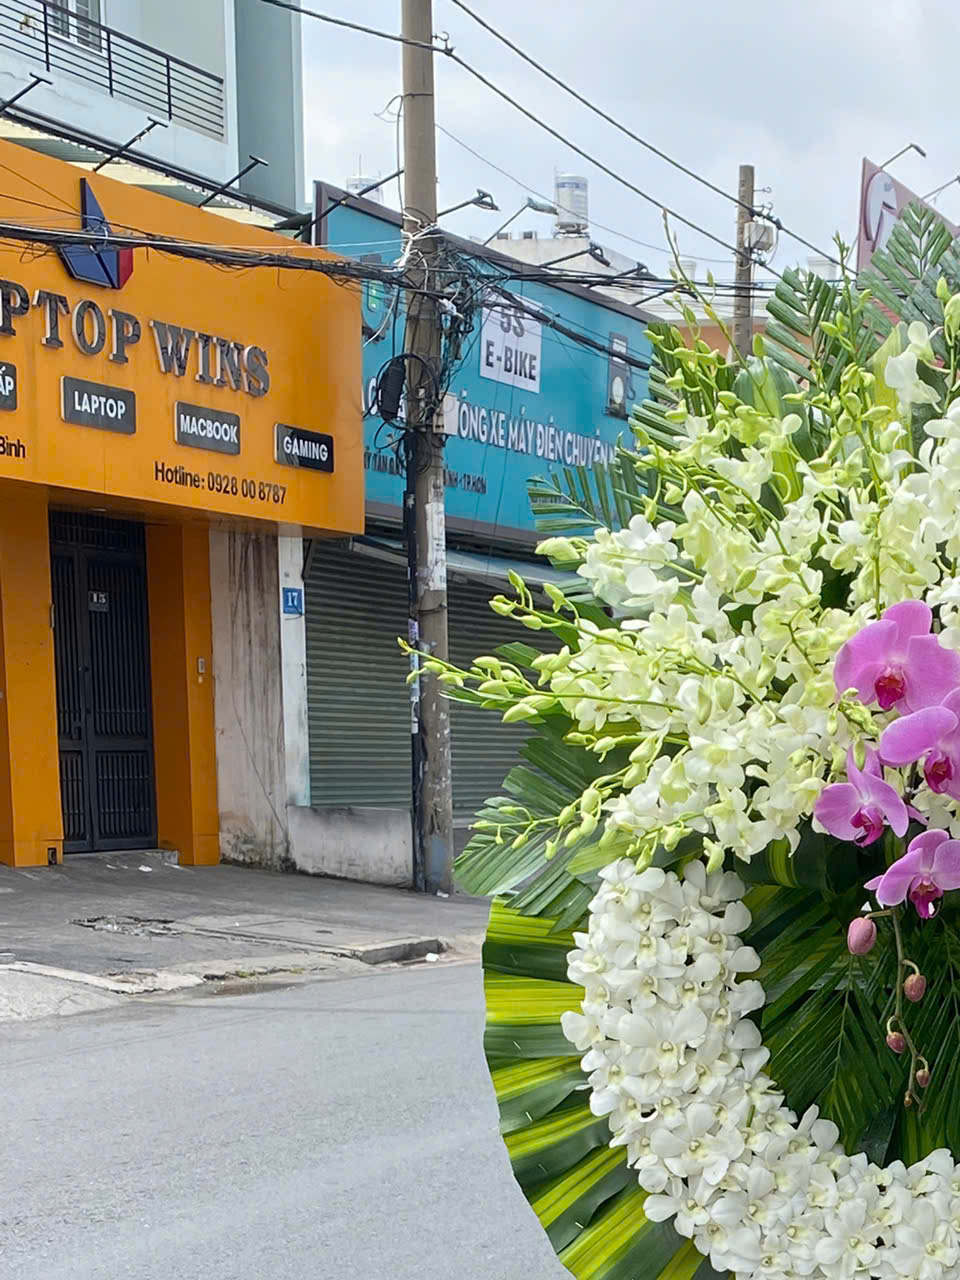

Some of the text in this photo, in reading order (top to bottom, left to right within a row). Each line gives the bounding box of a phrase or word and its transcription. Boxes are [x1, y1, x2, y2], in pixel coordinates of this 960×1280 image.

[148, 319, 271, 398] WINS
[74, 390, 126, 419] LAPTOP
[180, 413, 239, 444] MACBOOK
[489, 410, 506, 448] XE
[508, 405, 536, 456] MÁY
[282, 435, 329, 462] GAMING
[154, 460, 287, 505] Hotline: 0928 00 8787
[286, 591, 298, 606] 17
